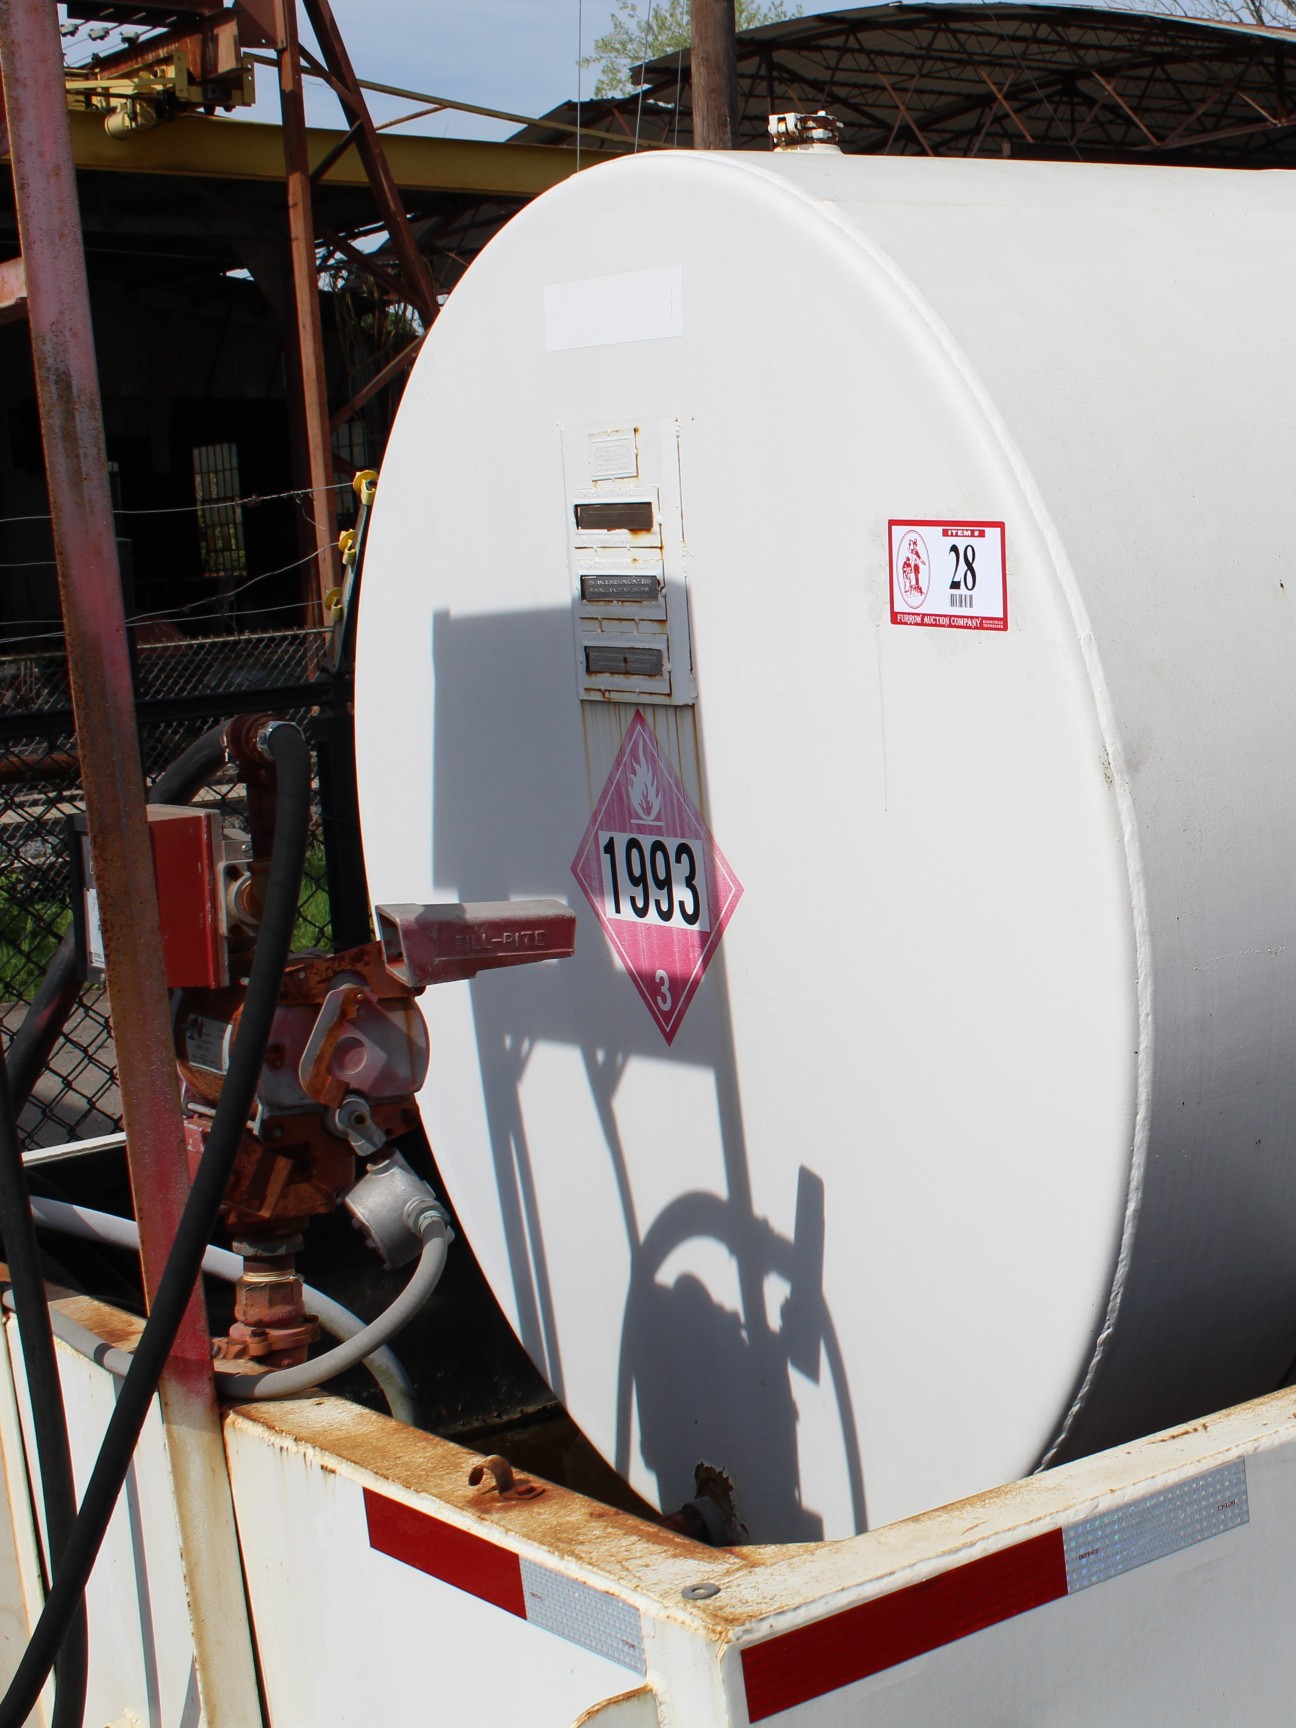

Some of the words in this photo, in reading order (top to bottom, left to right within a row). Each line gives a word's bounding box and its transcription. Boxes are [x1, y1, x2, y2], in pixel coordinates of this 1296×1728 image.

[949, 544, 976, 591] 28
[897, 613, 922, 625] FURROW
[923, 615, 950, 626] AUCTION
[951, 617, 982, 628] COMPANY
[603, 836, 701, 926] 1993
[455, 930, 546, 951] FILL-RITE
[655, 969, 672, 1012] 3
